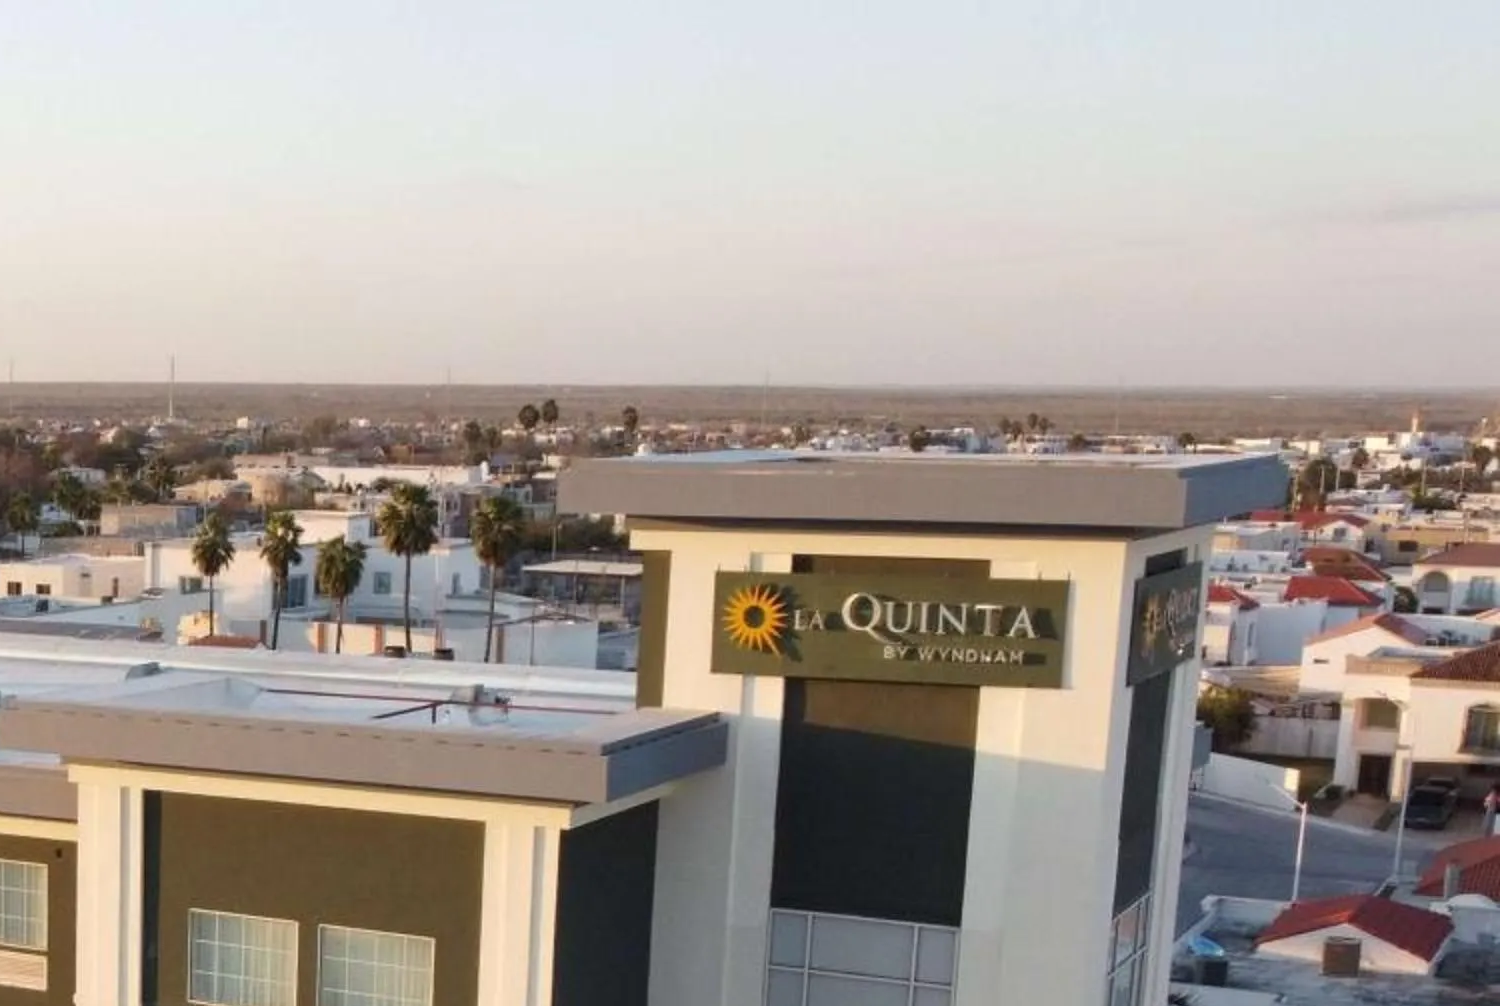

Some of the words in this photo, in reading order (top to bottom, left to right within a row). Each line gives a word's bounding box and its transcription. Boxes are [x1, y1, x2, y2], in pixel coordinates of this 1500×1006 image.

[793, 609, 825, 631] LA
[841, 592, 1038, 645] QUINTA
[883, 645, 910, 660] BY
[917, 646, 1025, 665] WYNDHAM
